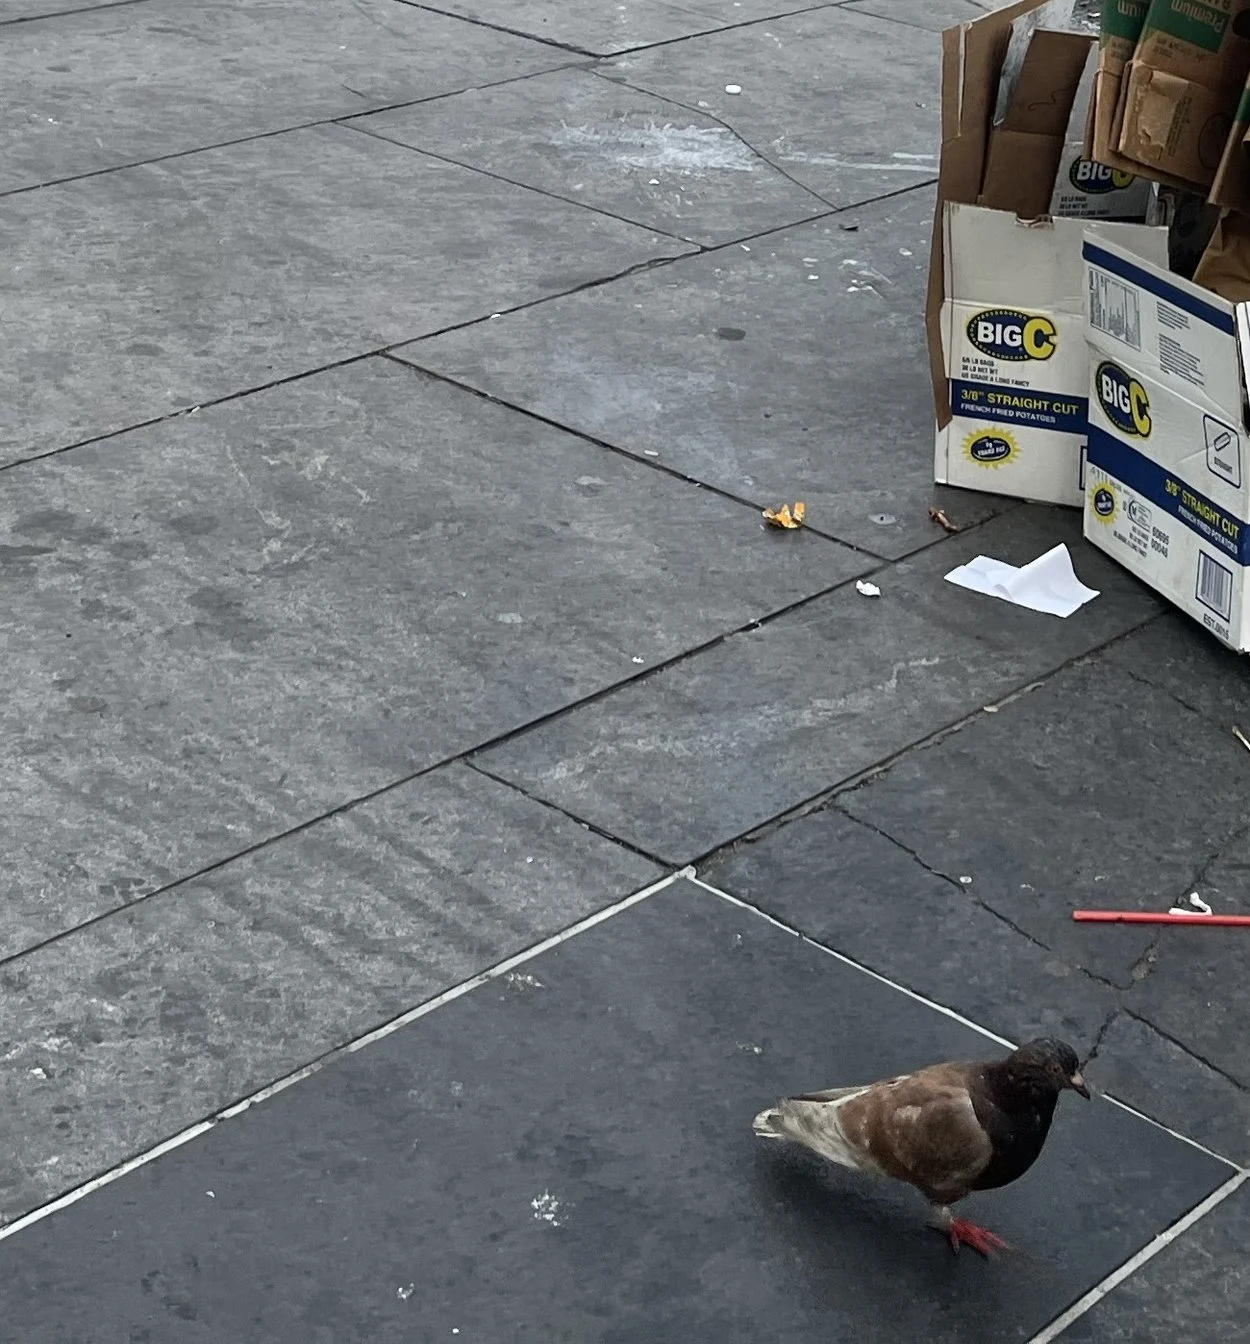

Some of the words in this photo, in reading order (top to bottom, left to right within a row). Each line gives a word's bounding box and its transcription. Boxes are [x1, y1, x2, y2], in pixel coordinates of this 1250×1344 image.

[960, 403, 991, 413] FRENCH
[992, 406, 1014, 417] FRIED
[1016, 410, 1056, 423] POTATOES
[987, 393, 1050, 411] STRAIGHT
[1053, 403, 1078, 415] CUT
[1182, 490, 1221, 527] STRAIGHT
[1222, 518, 1239, 539] CUT
